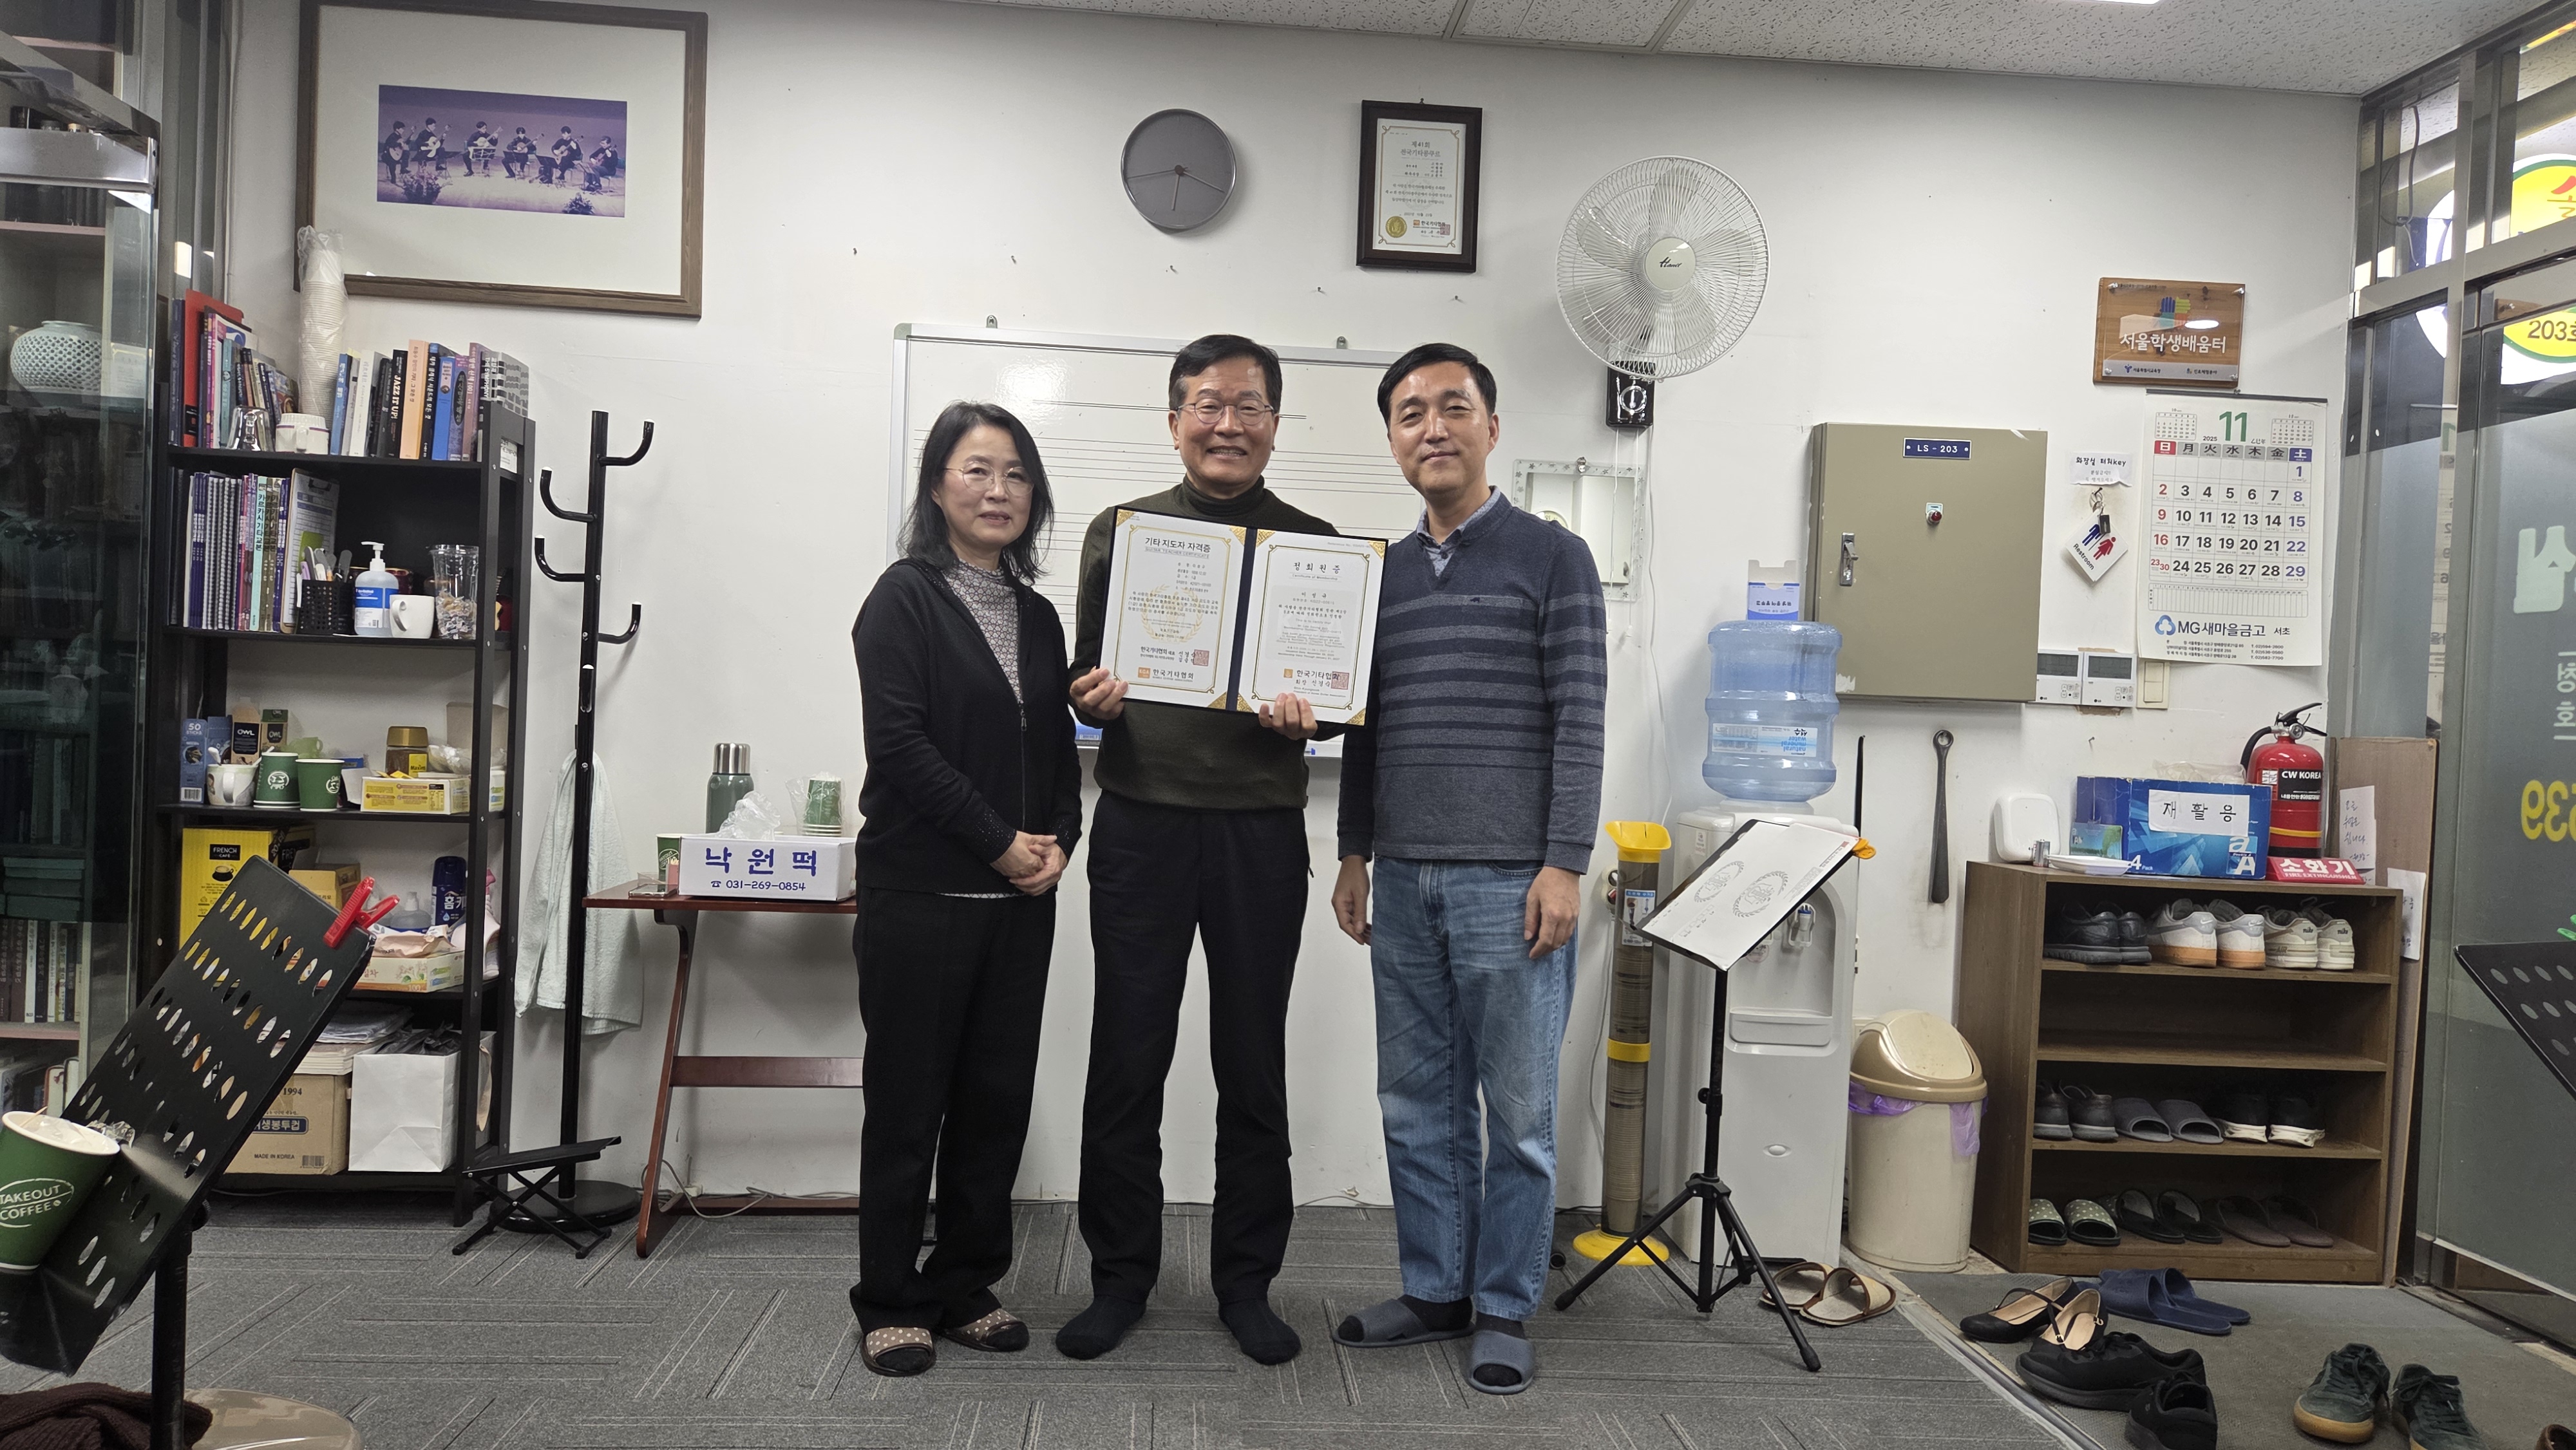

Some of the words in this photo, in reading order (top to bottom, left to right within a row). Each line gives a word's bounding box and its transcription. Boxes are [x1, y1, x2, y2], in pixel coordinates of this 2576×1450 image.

[2120, 333, 2226, 353] 서울학생배움터
[392, 375, 401, 395] JAZZ
[392, 395, 400, 405] IT
[2219, 411, 2247, 442] 11
[2160, 442, 2170, 451] 日
[2183, 444, 2193, 452] 月
[2204, 444, 2217, 453] 火
[2226, 446, 2239, 454] 水
[2248, 447, 2261, 455] 木
[2271, 447, 2284, 457] 金
[2294, 449, 2307, 458] 土
[2076, 457, 2096, 466] 화장실
[2296, 466, 2302, 476] 1
[2159, 484, 2167, 494] 2
[2181, 485, 2190, 496] 3
[2203, 487, 2211, 497] 4
[2226, 488, 2234, 498] 5
[2248, 489, 2256, 500] 6
[2271, 490, 2278, 500] 7
[2293, 491, 2302, 502] 8
[255, 494, 266, 552] 카르카시기타교본
[2158, 509, 2166, 520] 9
[2176, 511, 2191, 521] 10
[2199, 512, 2211, 523] 11
[2221, 513, 2236, 523] 12
[2243, 514, 2258, 525] 13
[2265, 515, 2281, 526] 14
[2289, 516, 2306, 527] 15
[1145, 538, 1160, 546] 기타
[1162, 540, 1185, 549] 지도자
[1188, 543, 1211, 553] 자격증
[2154, 534, 2168, 545] 16
[2175, 536, 2190, 547] 17
[2197, 537, 2211, 547] 18
[2219, 538, 2234, 549] 19
[2240, 539, 2258, 550] 20
[2264, 540, 2280, 551] 21
[2287, 541, 2306, 552] 22
[2073, 543, 2094, 570] Restroom
[2173, 561, 2190, 572] 24
[2195, 562, 2211, 573] 25
[2216, 563, 2233, 574] 26
[2239, 565, 2256, 576] 27
[2262, 565, 2280, 576] 28
[2286, 566, 2306, 577] 29
[2273, 626, 2291, 636] 서초
[1153, 668, 1194, 679] 한국기타협회
[2345, 800, 2358, 811] 오늘
[2130, 854, 2142, 870] 4
[2237, 856, 2256, 876] A
[2280, 858, 2356, 876] 소화기
[726, 880, 806, 892] 031-269-0854
[0, 1185, 61, 1205] TAKEOUT
[0, 1201, 52, 1220] COFFEE
